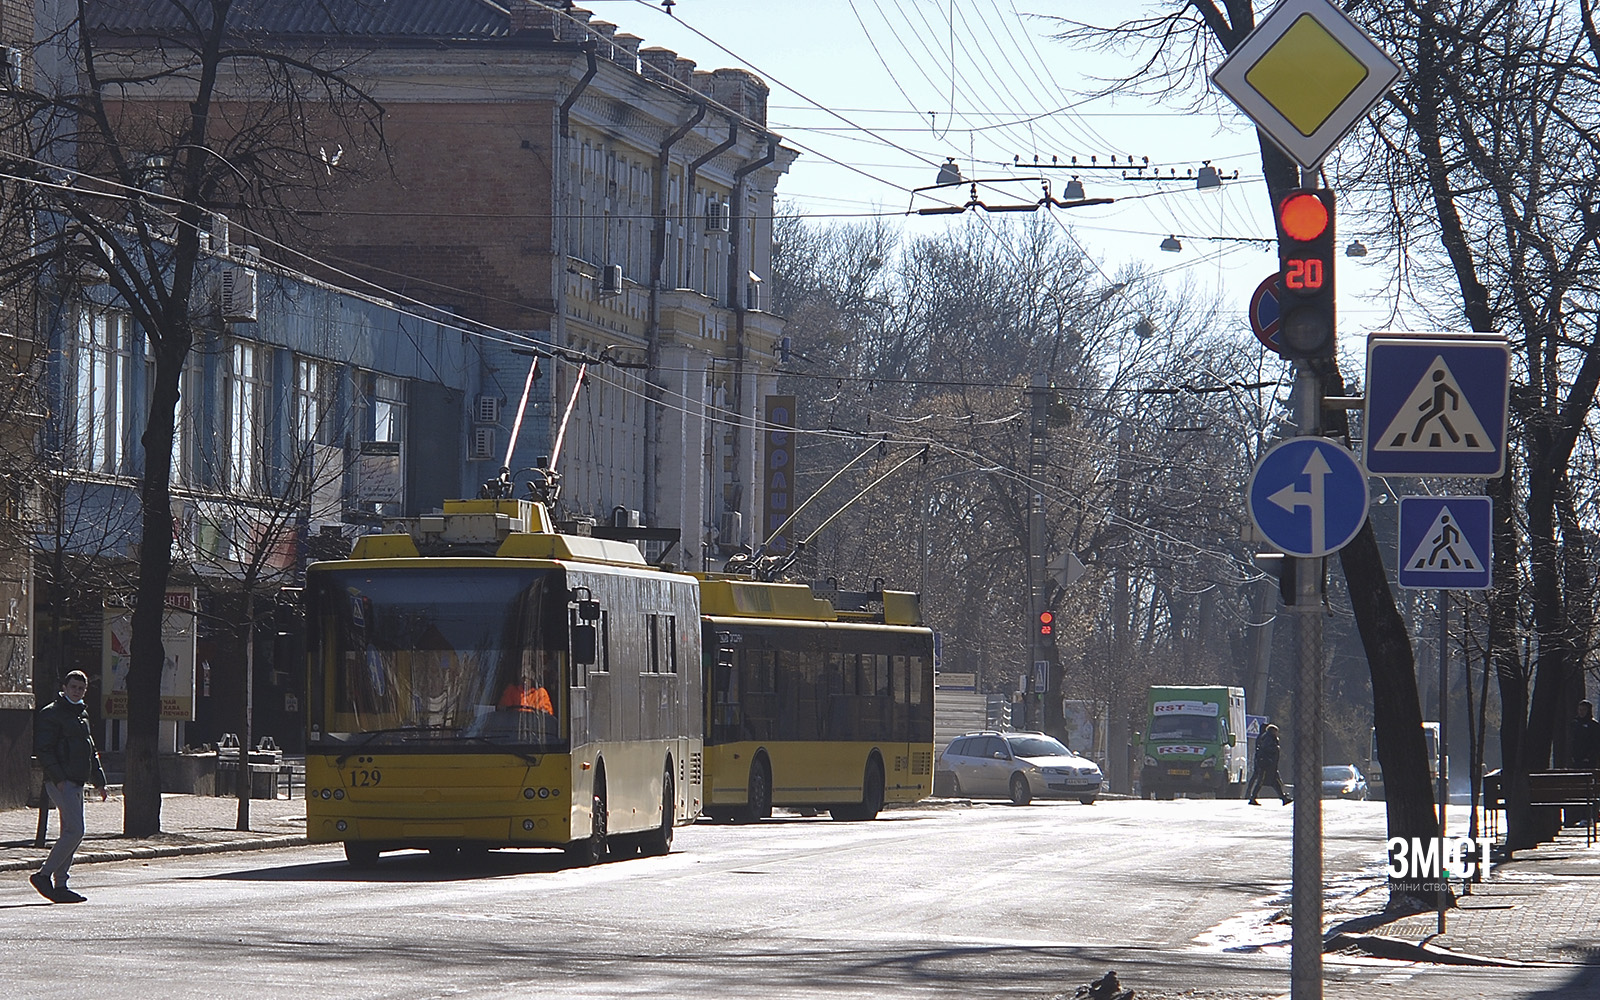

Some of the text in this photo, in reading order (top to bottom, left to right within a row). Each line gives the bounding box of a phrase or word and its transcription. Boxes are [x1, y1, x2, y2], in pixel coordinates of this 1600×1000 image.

[1286, 258, 1323, 289] 20
[1155, 704, 1185, 713] RST
[1159, 746, 1204, 754] RST
[350, 769, 382, 788] 129
